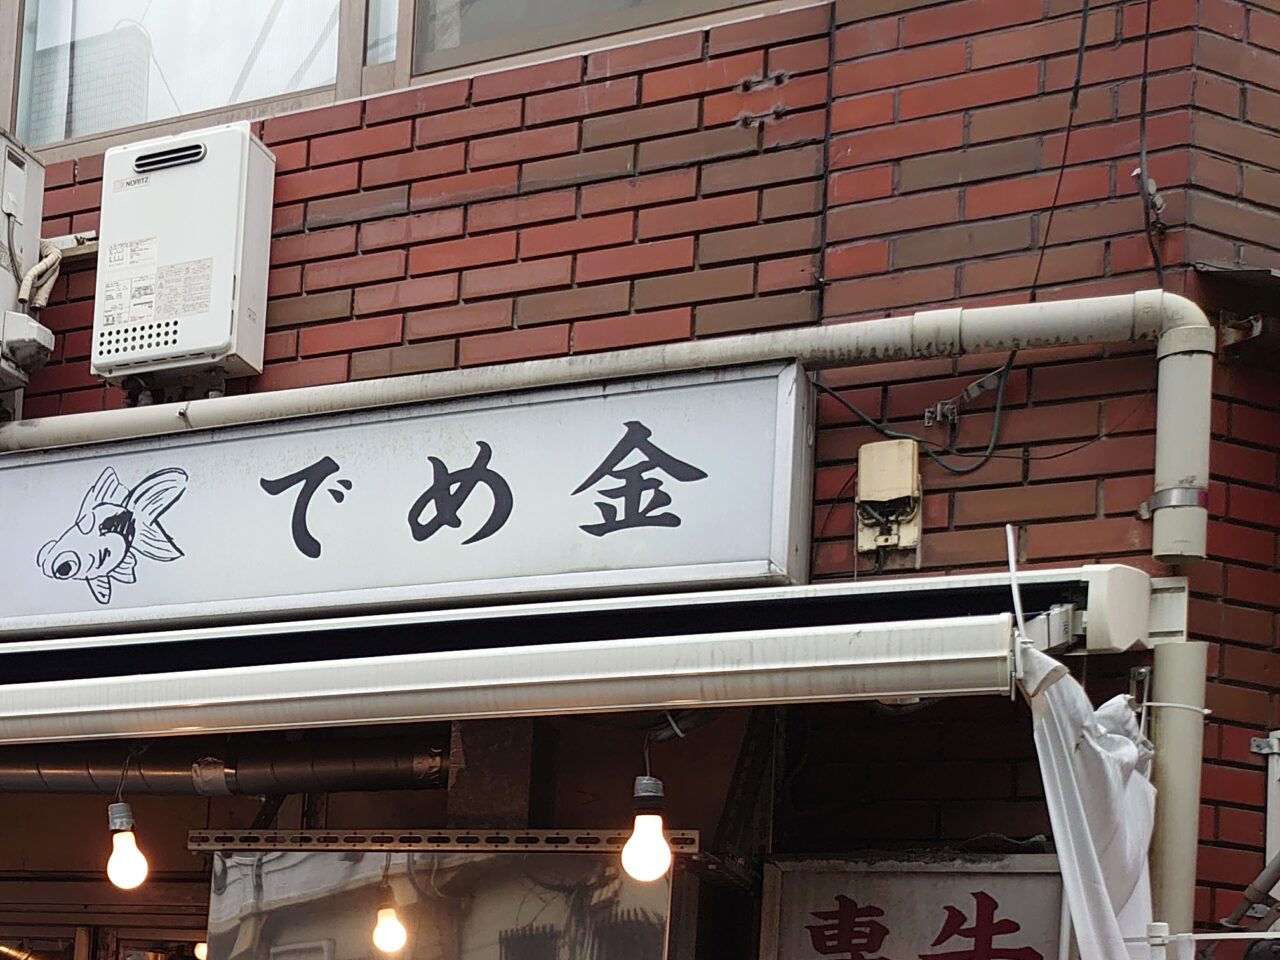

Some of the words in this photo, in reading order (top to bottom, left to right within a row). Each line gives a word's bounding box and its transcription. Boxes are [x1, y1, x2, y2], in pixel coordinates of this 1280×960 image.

[125, 177, 149, 188] NORITZ
[260, 420, 708, 559] でめ金
